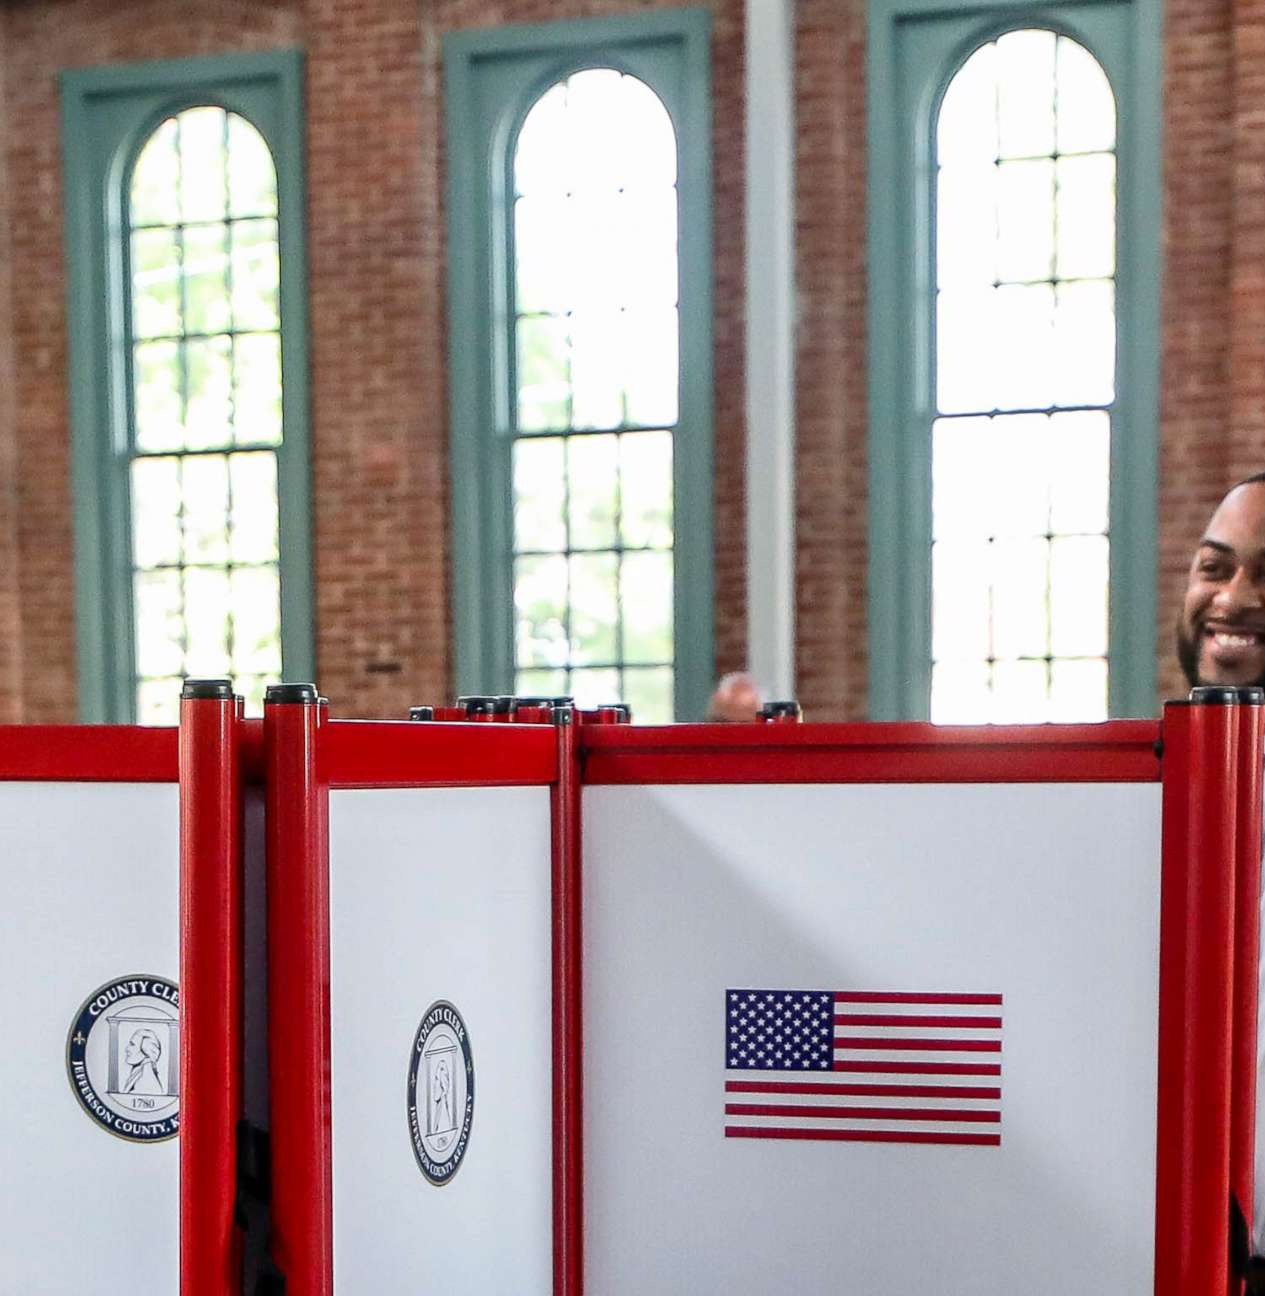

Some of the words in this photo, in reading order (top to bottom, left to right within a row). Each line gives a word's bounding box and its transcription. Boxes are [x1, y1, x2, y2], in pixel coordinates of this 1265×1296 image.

[89, 980, 149, 1016] COUNTY
[152, 982, 179, 1006] CLE
[416, 1007, 443, 1053] COUNTY
[443, 1008, 465, 1043] CLERK
[72, 1060, 115, 1123] JEFFERSON
[114, 1118, 170, 1135] COUNTY,
[132, 1098, 155, 1109] 1780
